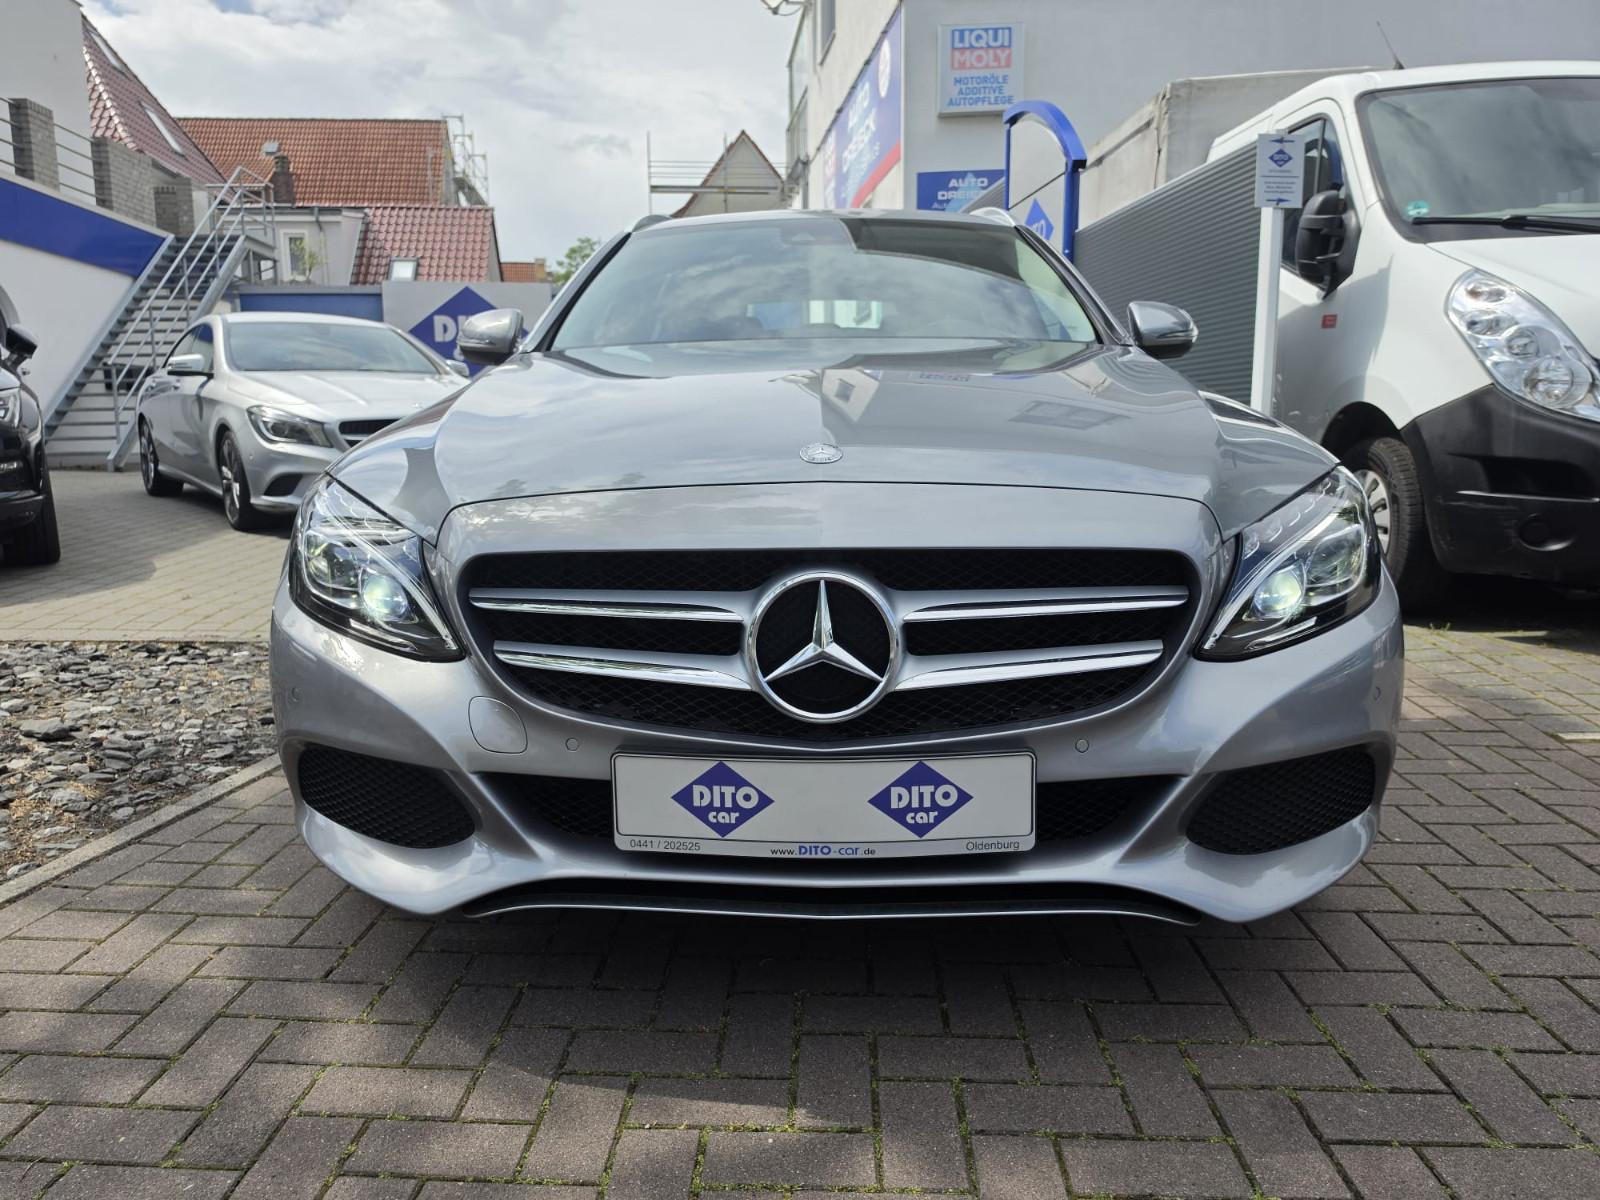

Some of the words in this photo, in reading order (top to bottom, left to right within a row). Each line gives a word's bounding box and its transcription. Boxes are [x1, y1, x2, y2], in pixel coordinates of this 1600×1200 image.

[953, 29, 1010, 48] LIQUI
[953, 49, 1010, 68] MOLY
[954, 74, 1008, 86] MOTORÖLE
[957, 86, 1004, 96] ADDITIVE
[947, 96, 1015, 107] AUTOPFLEGE
[948, 177, 989, 188] AUTO
[692, 784, 759, 809] DITO
[890, 784, 958, 809] DITO
[708, 811, 740, 824] car
[906, 811, 938, 824] car
[629, 838, 653, 849] 0441
[664, 839, 700, 851] 202525
[965, 840, 1020, 851] Oldenburg
